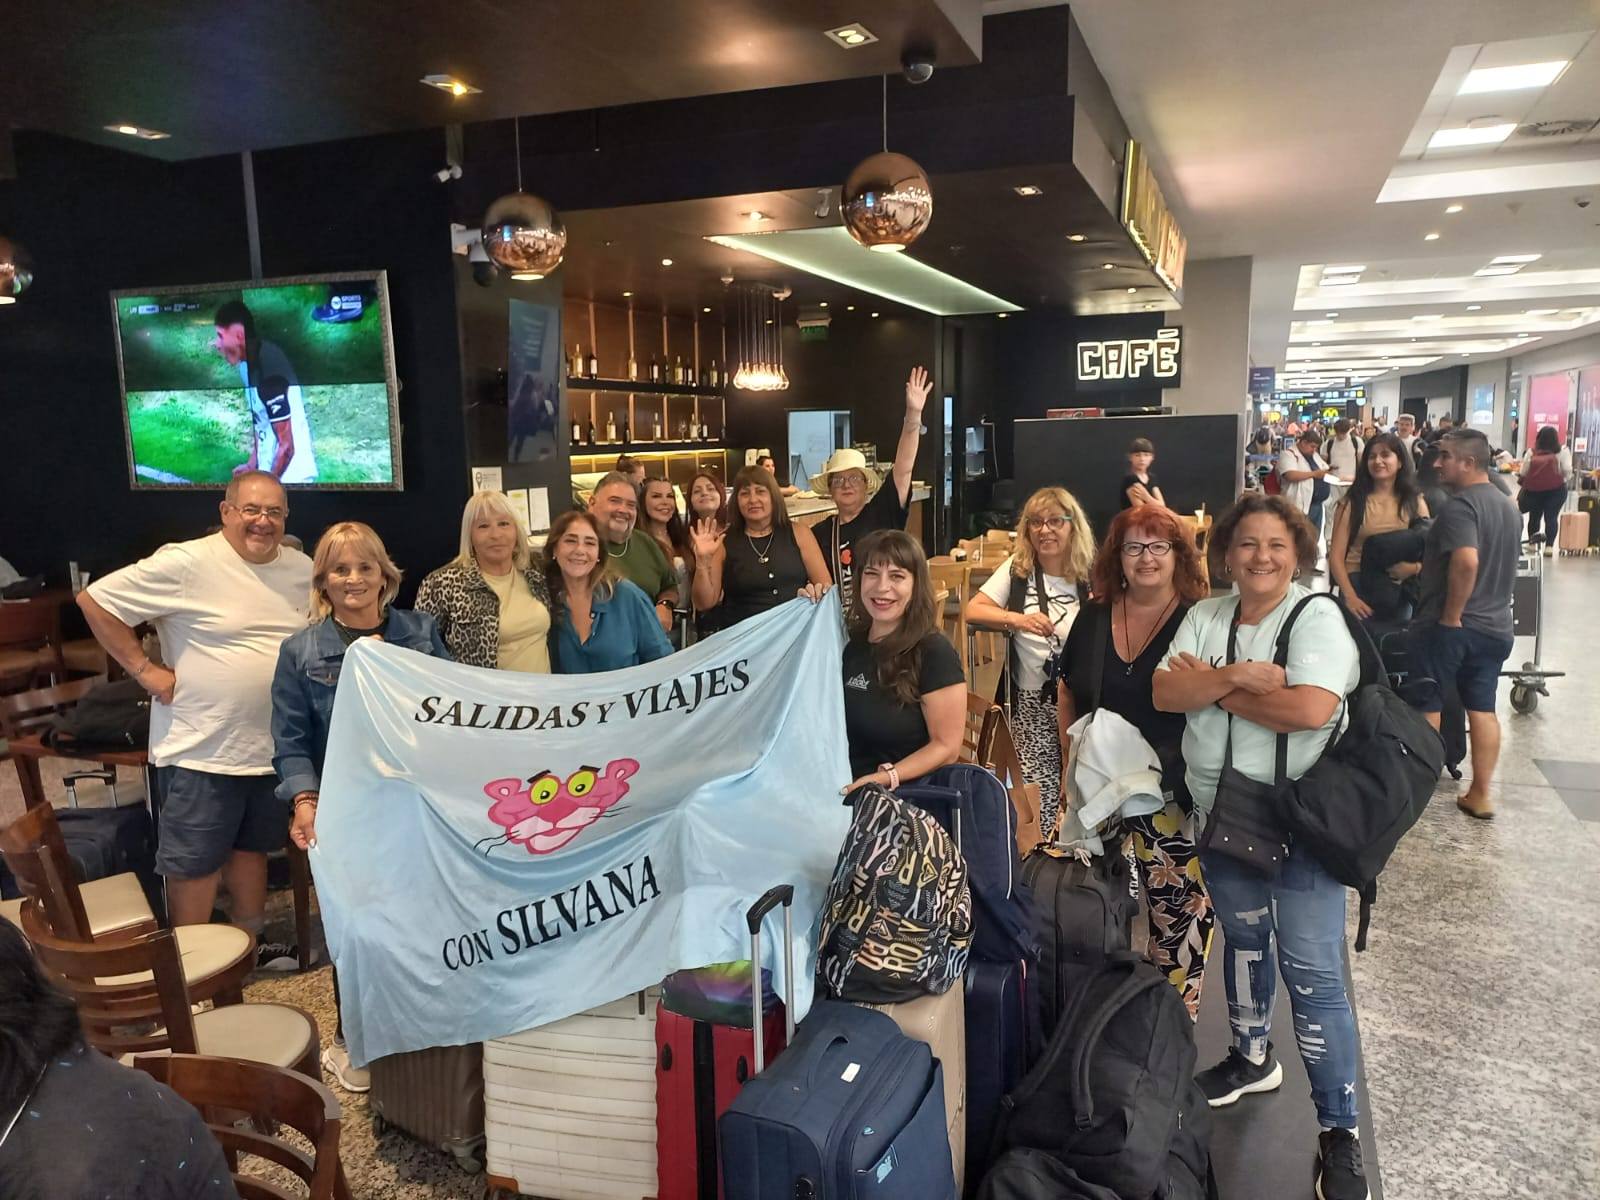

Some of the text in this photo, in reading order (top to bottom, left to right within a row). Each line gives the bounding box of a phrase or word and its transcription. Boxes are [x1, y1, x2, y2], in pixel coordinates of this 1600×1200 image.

[1077, 328, 1180, 380] CAFÉ
[414, 695, 590, 731] SALIDAS
[622, 658, 751, 719] VIAJES
[442, 855, 662, 971] CON SILVANA
